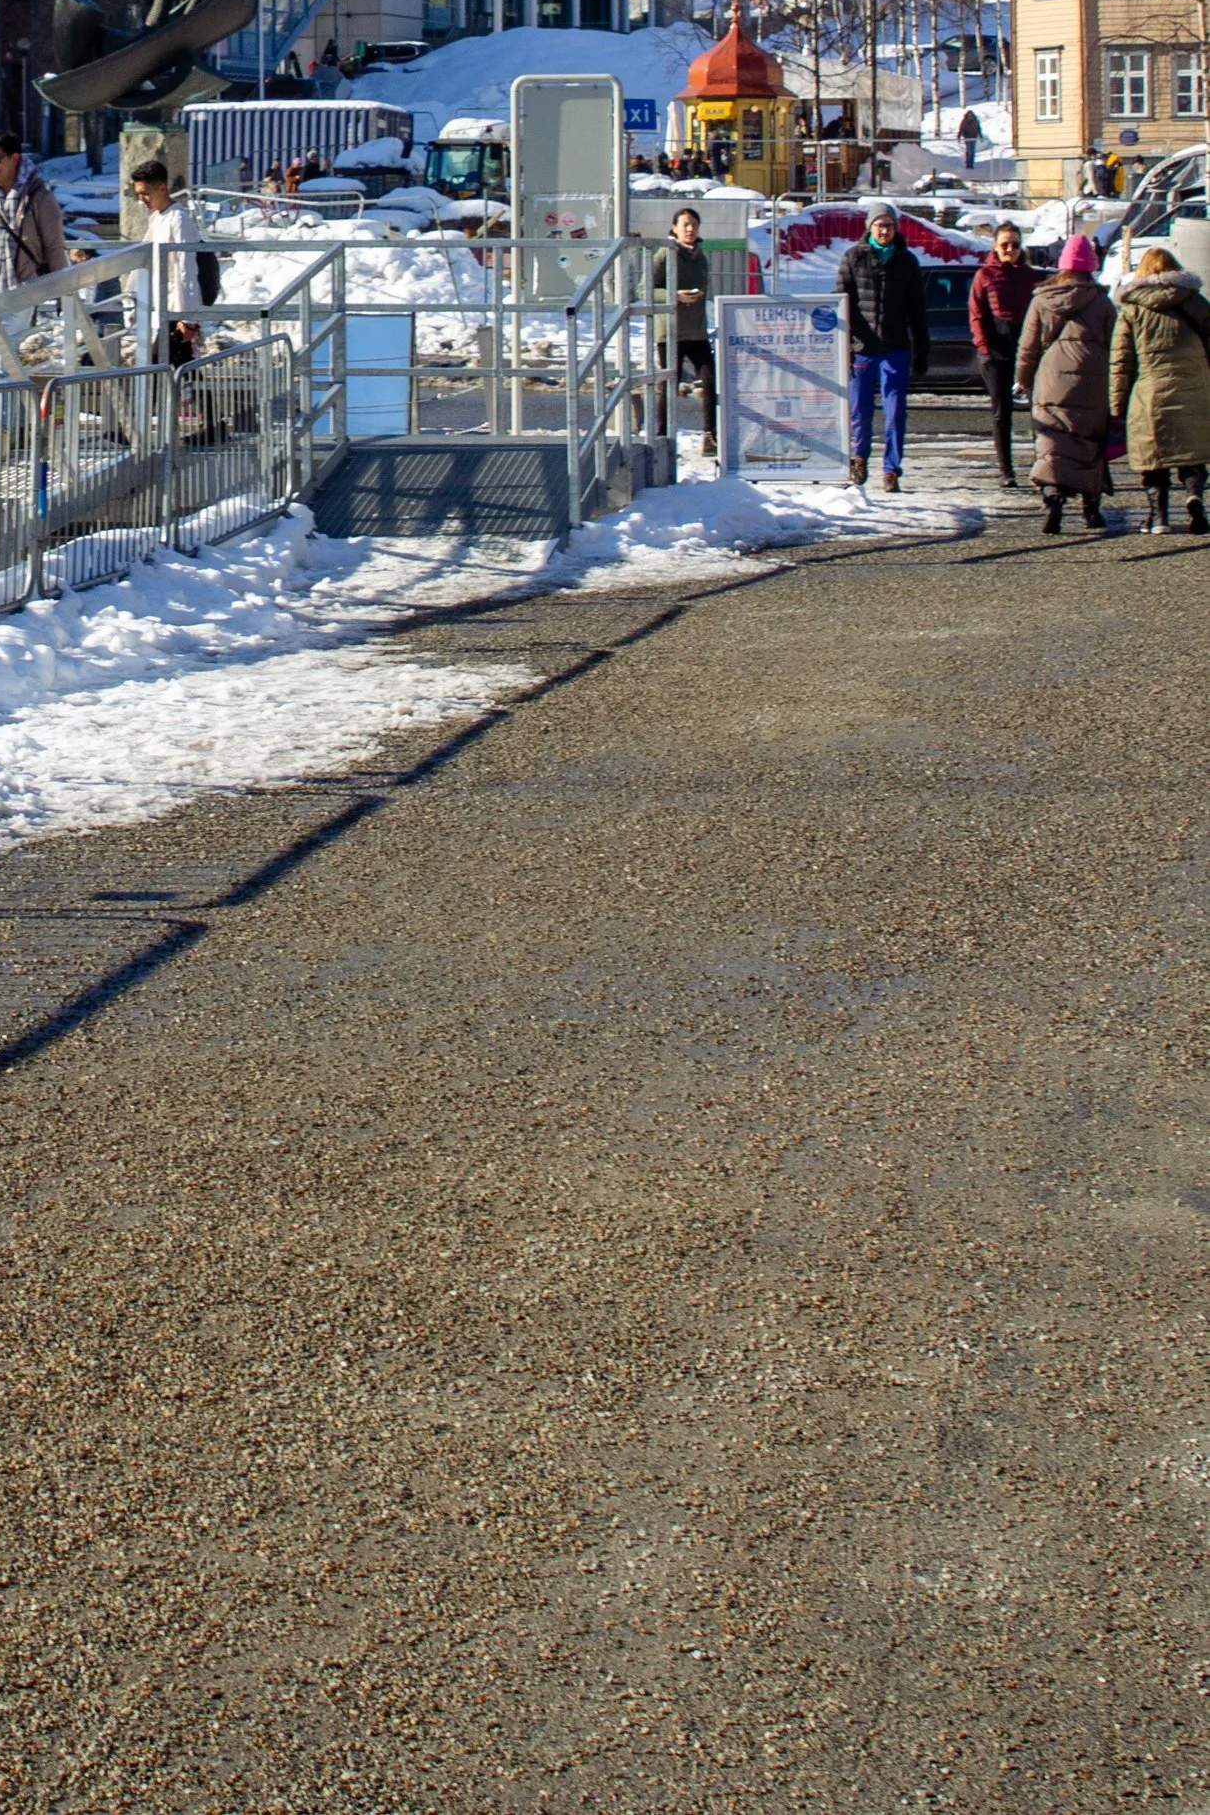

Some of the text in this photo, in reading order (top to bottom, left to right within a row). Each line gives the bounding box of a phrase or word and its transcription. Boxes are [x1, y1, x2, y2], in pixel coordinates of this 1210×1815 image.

[755, 308, 796, 321] HERMES
[783, 334, 805, 345] BOAT
[808, 333, 834, 345] TRIPS
